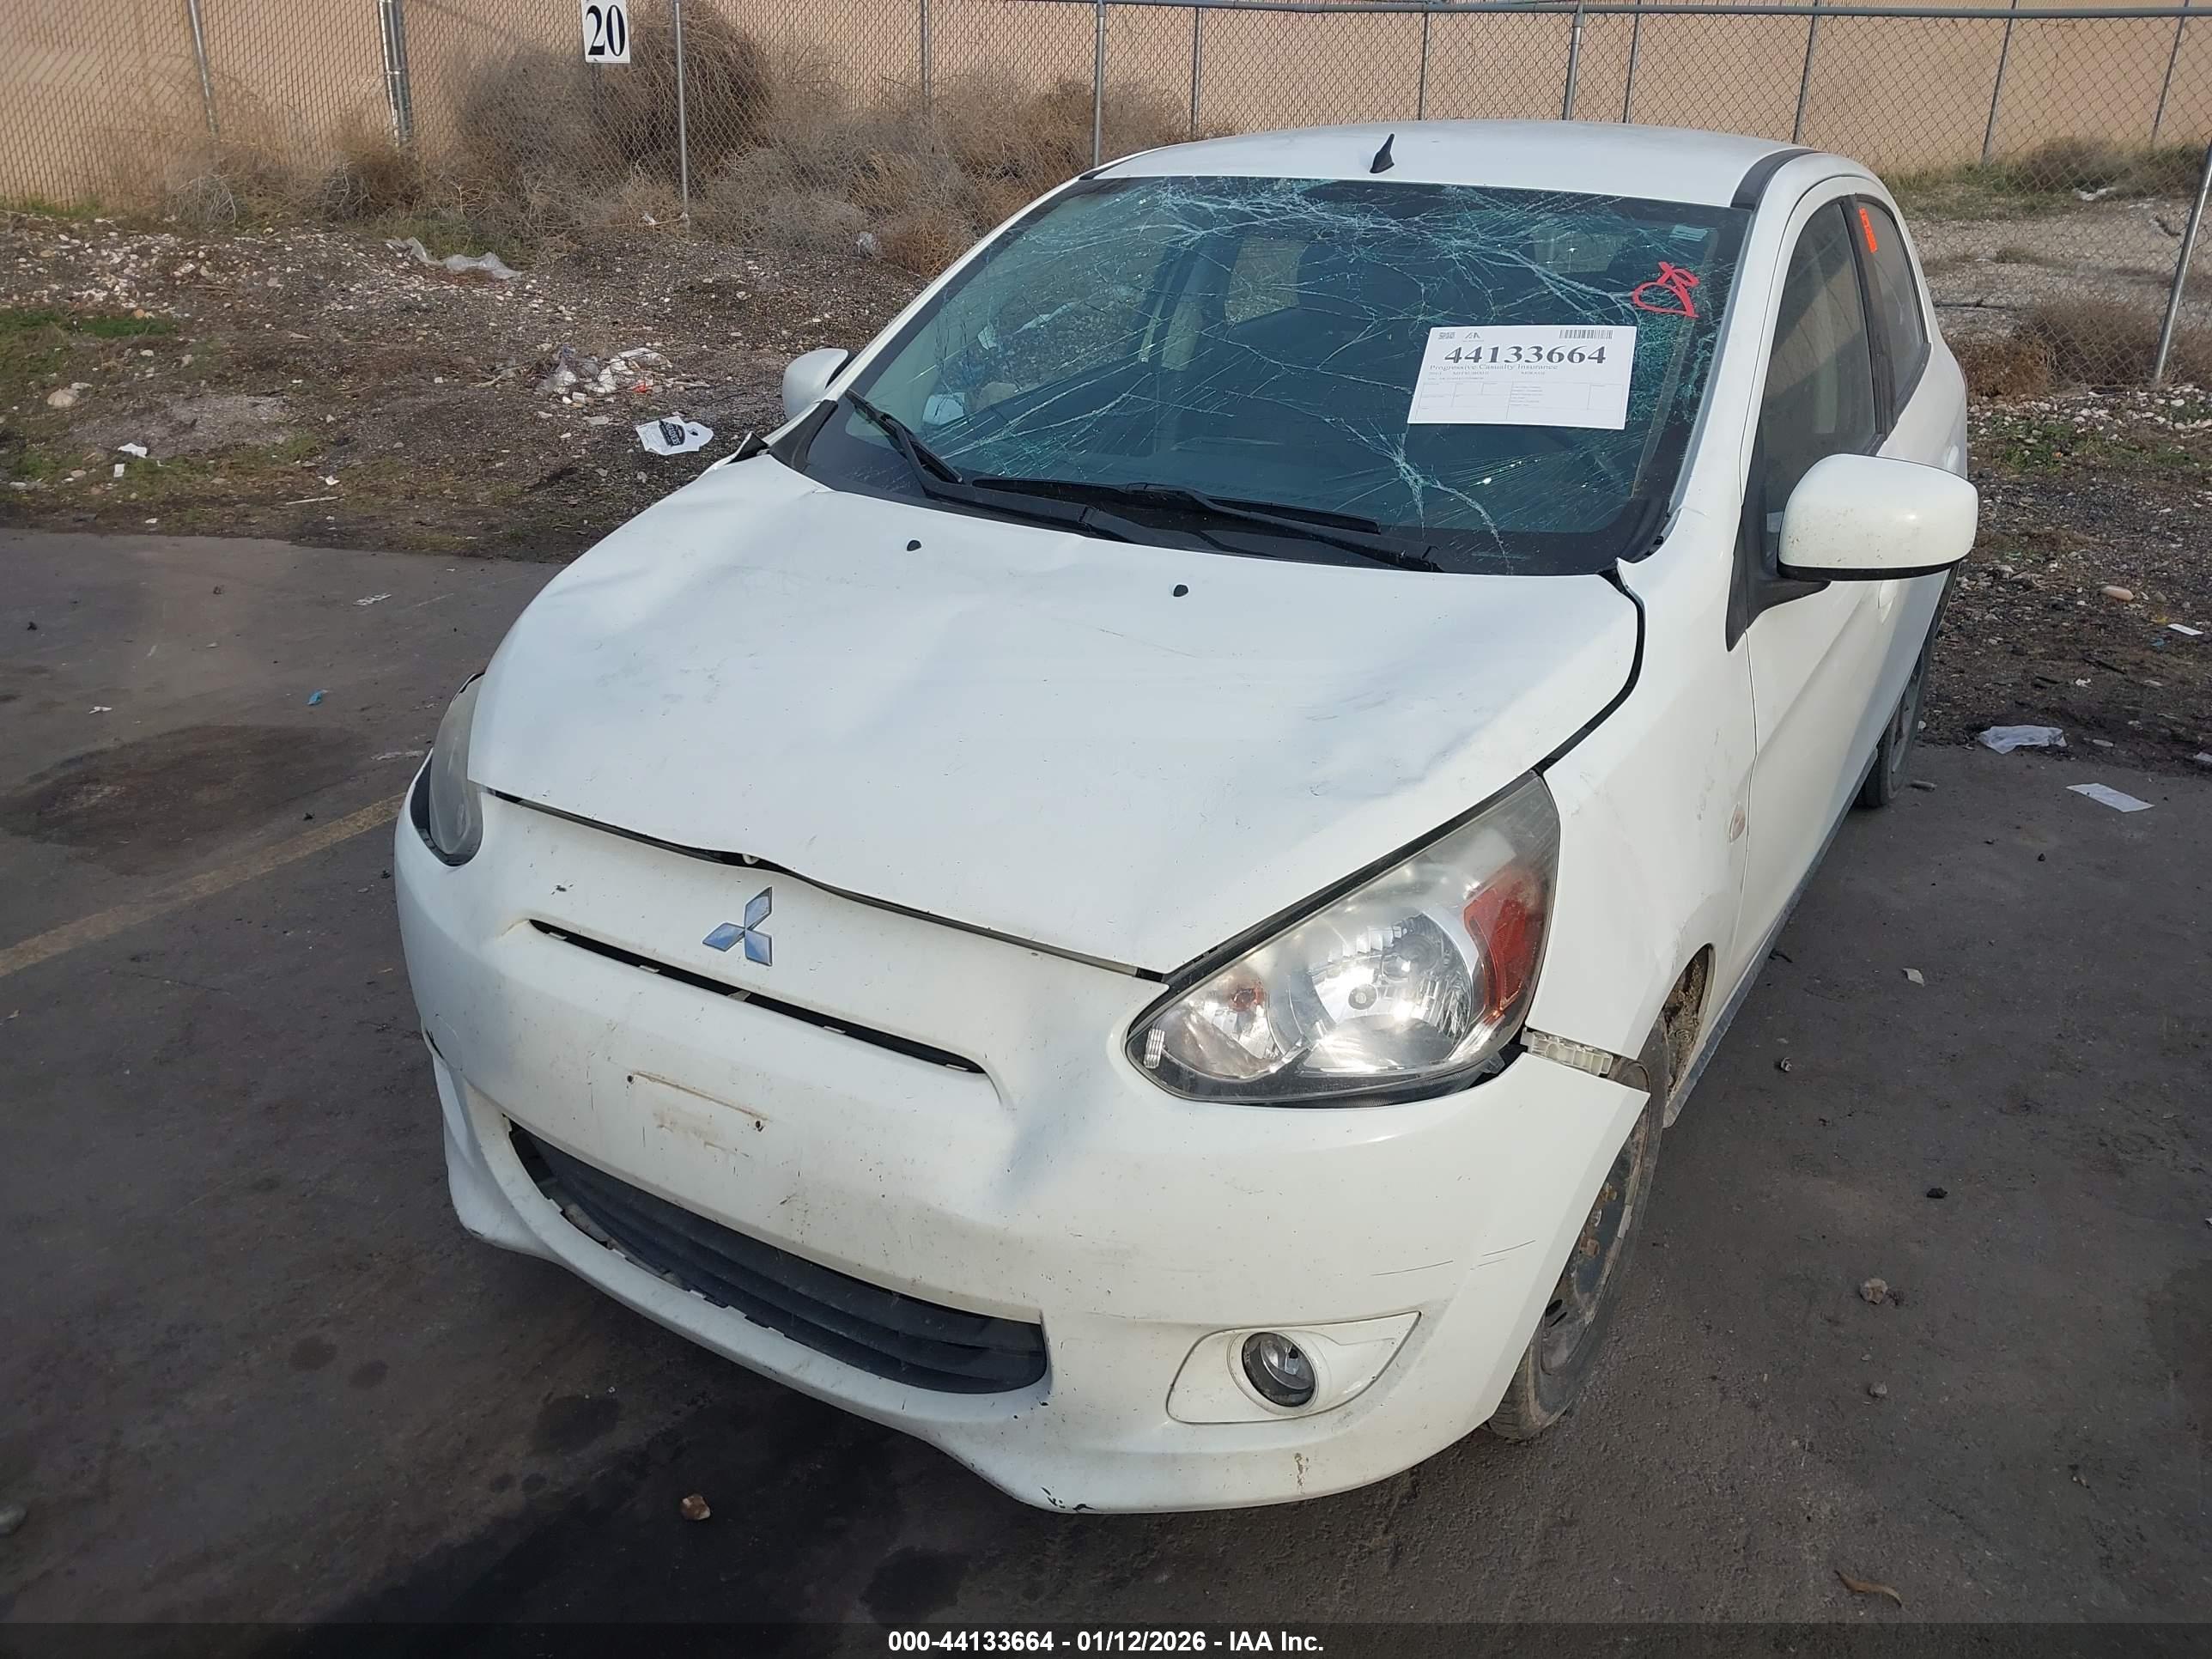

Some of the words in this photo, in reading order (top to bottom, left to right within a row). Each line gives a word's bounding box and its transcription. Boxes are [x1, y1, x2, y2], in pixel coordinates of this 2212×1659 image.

[586, 4, 626, 57] 20
[1443, 345, 1607, 364] 44133664
[1429, 363, 1478, 372] Progressive
